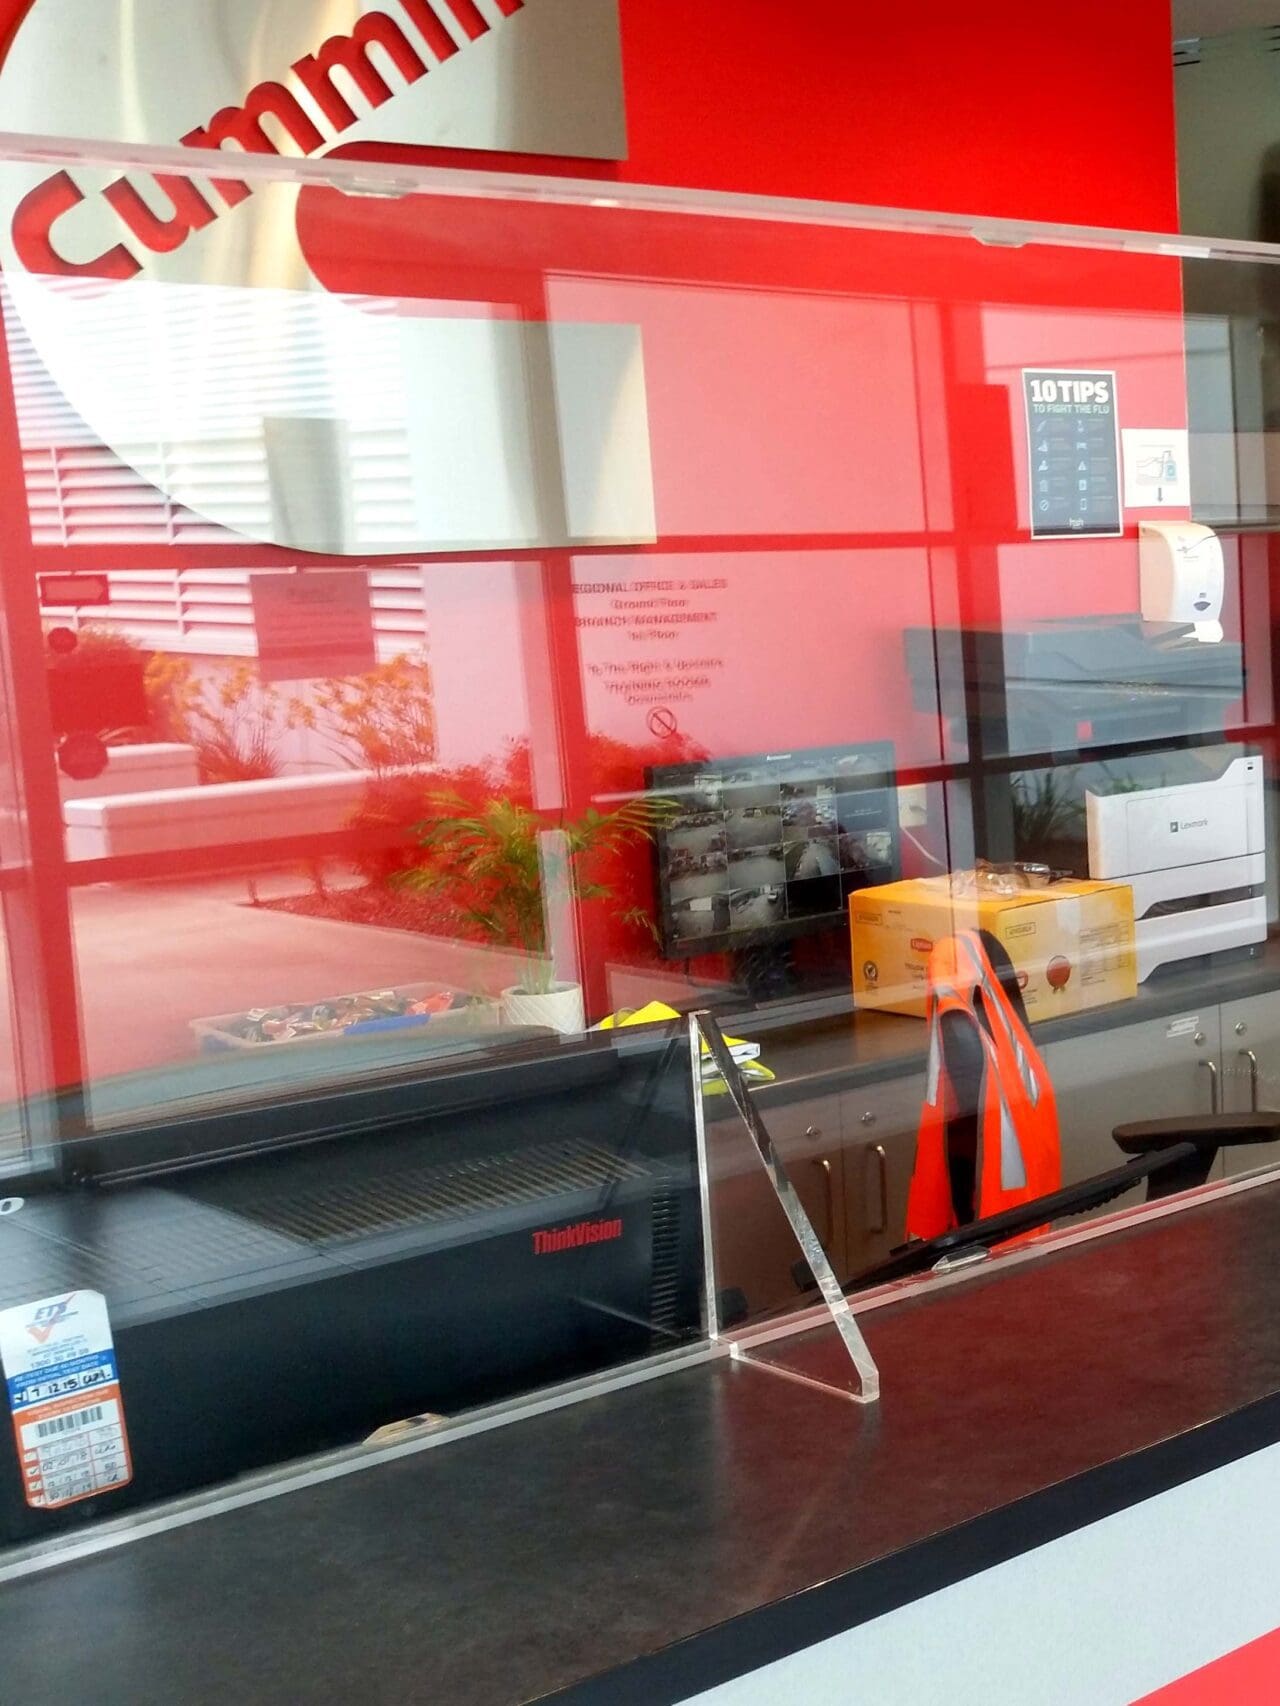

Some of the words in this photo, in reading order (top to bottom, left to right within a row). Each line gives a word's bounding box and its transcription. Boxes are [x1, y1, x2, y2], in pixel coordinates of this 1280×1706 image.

[11, 0, 524, 299] Cummi
[1030, 380, 1057, 403] 10
[1057, 380, 1109, 404] TIPS
[1033, 404, 1046, 414] TO
[1046, 404, 1072, 414] FIGHT
[1074, 404, 1092, 414] THE
[1092, 404, 1110, 414] FLU
[532, 1219, 623, 1255] ThinkVision
